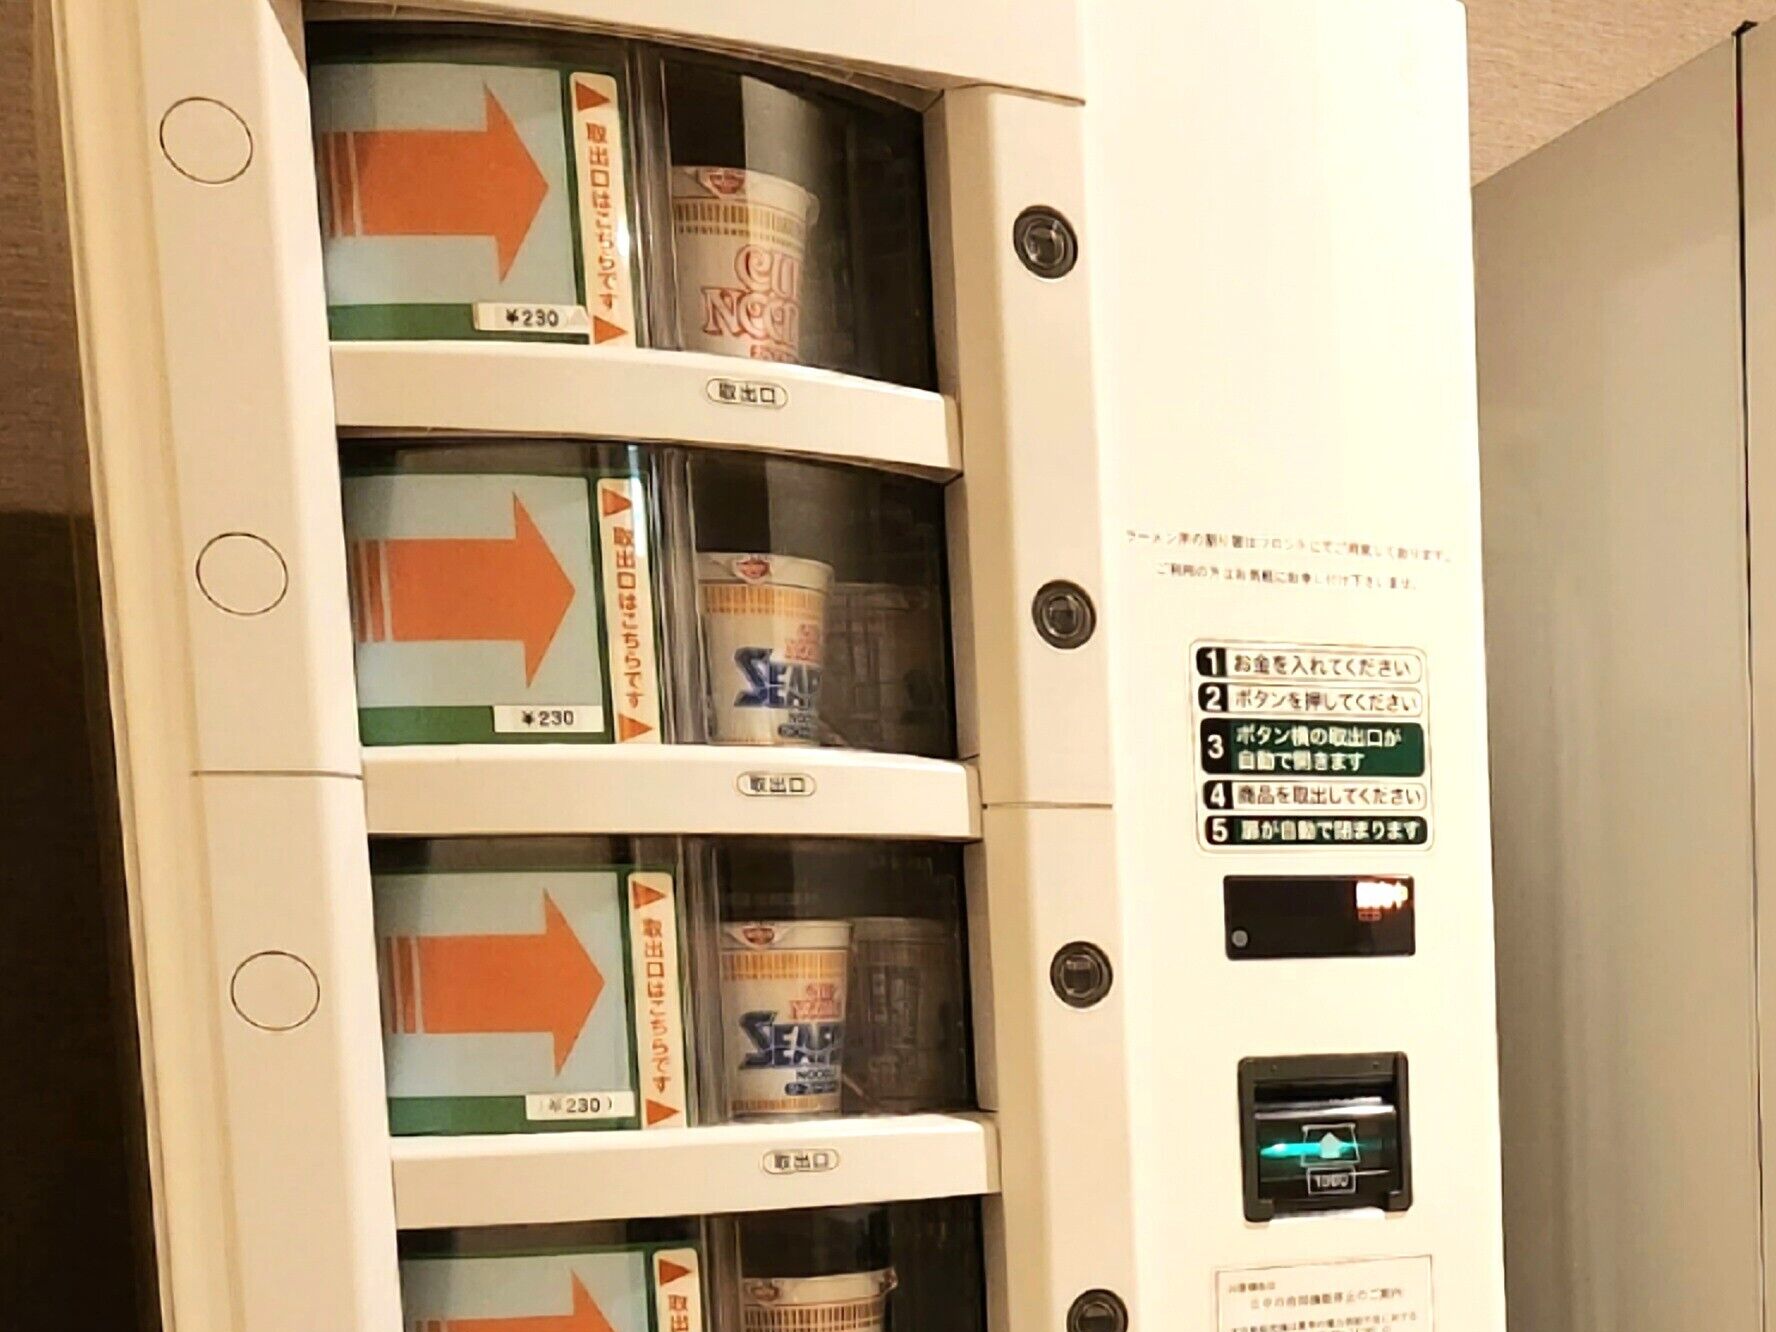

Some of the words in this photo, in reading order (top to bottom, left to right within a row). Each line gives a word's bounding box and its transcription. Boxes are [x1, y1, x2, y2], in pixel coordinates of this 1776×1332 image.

[506, 309, 559, 329] ¥230
[717, 384, 777, 405] 取出口
[612, 526, 644, 708] 取出口はこちらです
[1205, 651, 1219, 675] 1
[1233, 654, 1411, 677] お金を入れてください
[1205, 686, 1222, 711] 2
[1235, 689, 1418, 713] ボタンを押してください
[521, 709, 575, 727] ¥230
[1207, 735, 1223, 759] 3
[1237, 750, 1366, 772] 自動で開きます
[749, 774, 806, 794] 取出口
[1209, 784, 1226, 808] 4
[1237, 784, 1421, 806] 商品を取出してください
[1211, 819, 1228, 842] 5
[641, 917, 671, 1093] 取出口はこちらです
[548, 1096, 602, 1117] ¥230
[773, 1151, 829, 1171] 取出口
